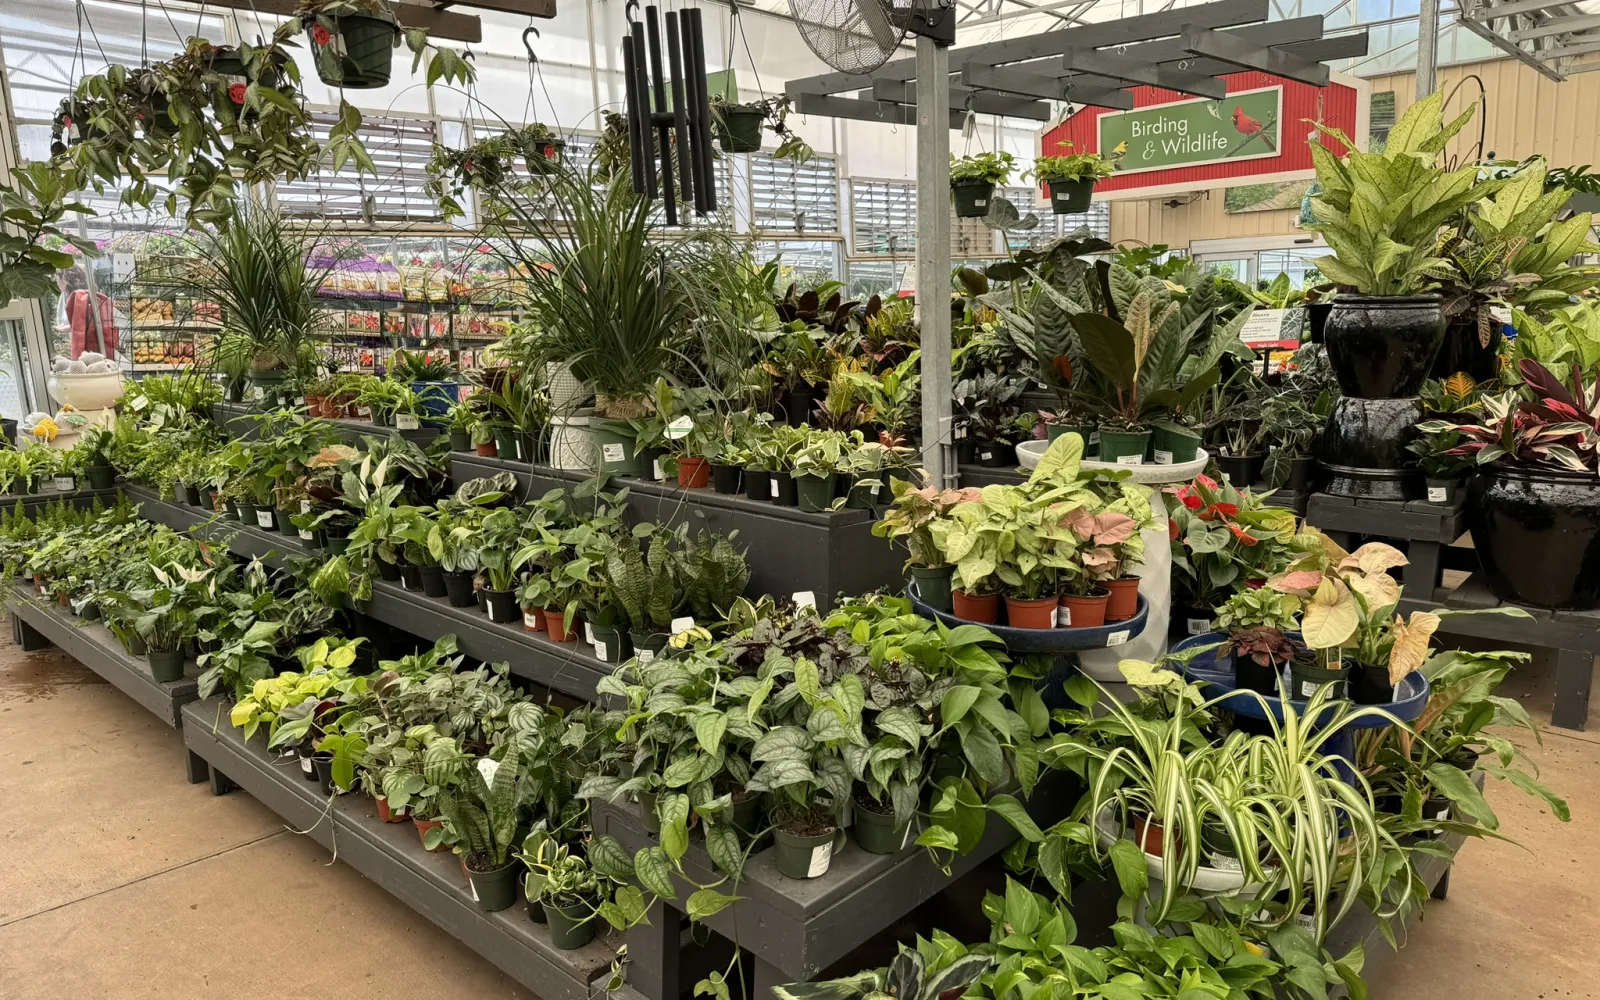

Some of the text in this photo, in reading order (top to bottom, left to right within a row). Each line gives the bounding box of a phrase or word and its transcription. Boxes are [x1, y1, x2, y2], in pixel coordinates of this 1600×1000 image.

[1132, 116, 1188, 137] Birding
[1142, 131, 1228, 160] & Wildlife
